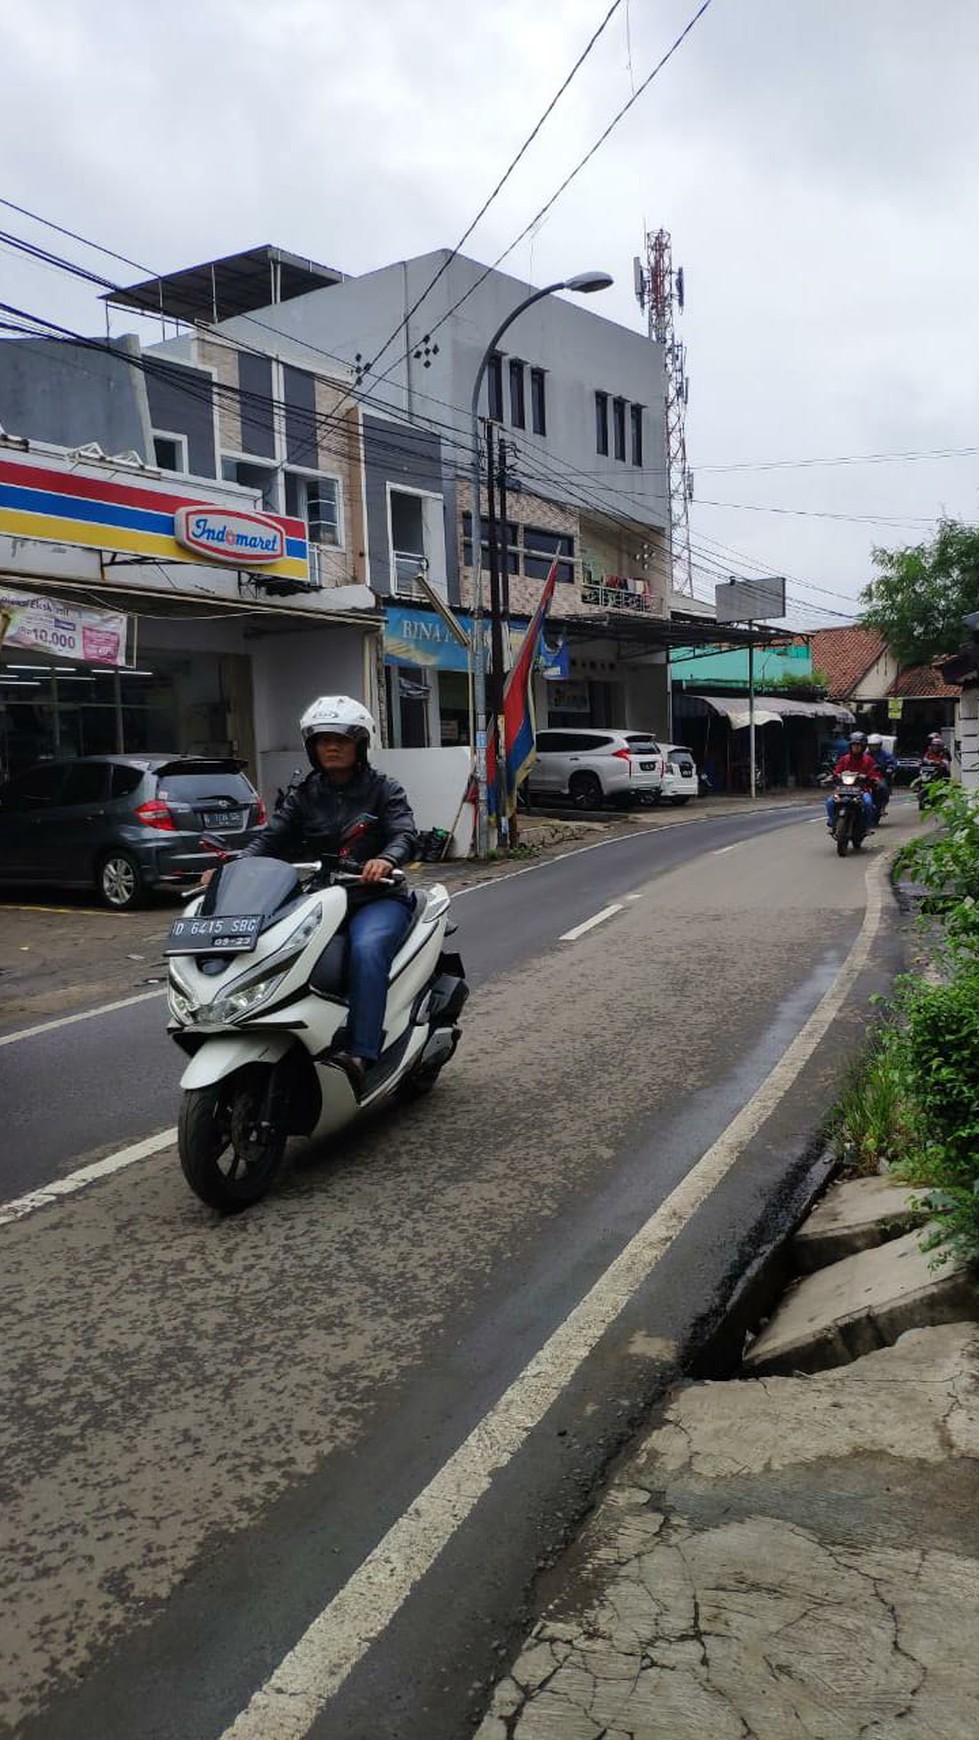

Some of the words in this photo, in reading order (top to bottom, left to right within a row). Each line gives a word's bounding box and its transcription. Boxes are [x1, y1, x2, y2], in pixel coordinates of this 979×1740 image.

[192, 519, 277, 551] Indomaret
[403, 620, 440, 642] BINA
[175, 922, 184, 935] D
